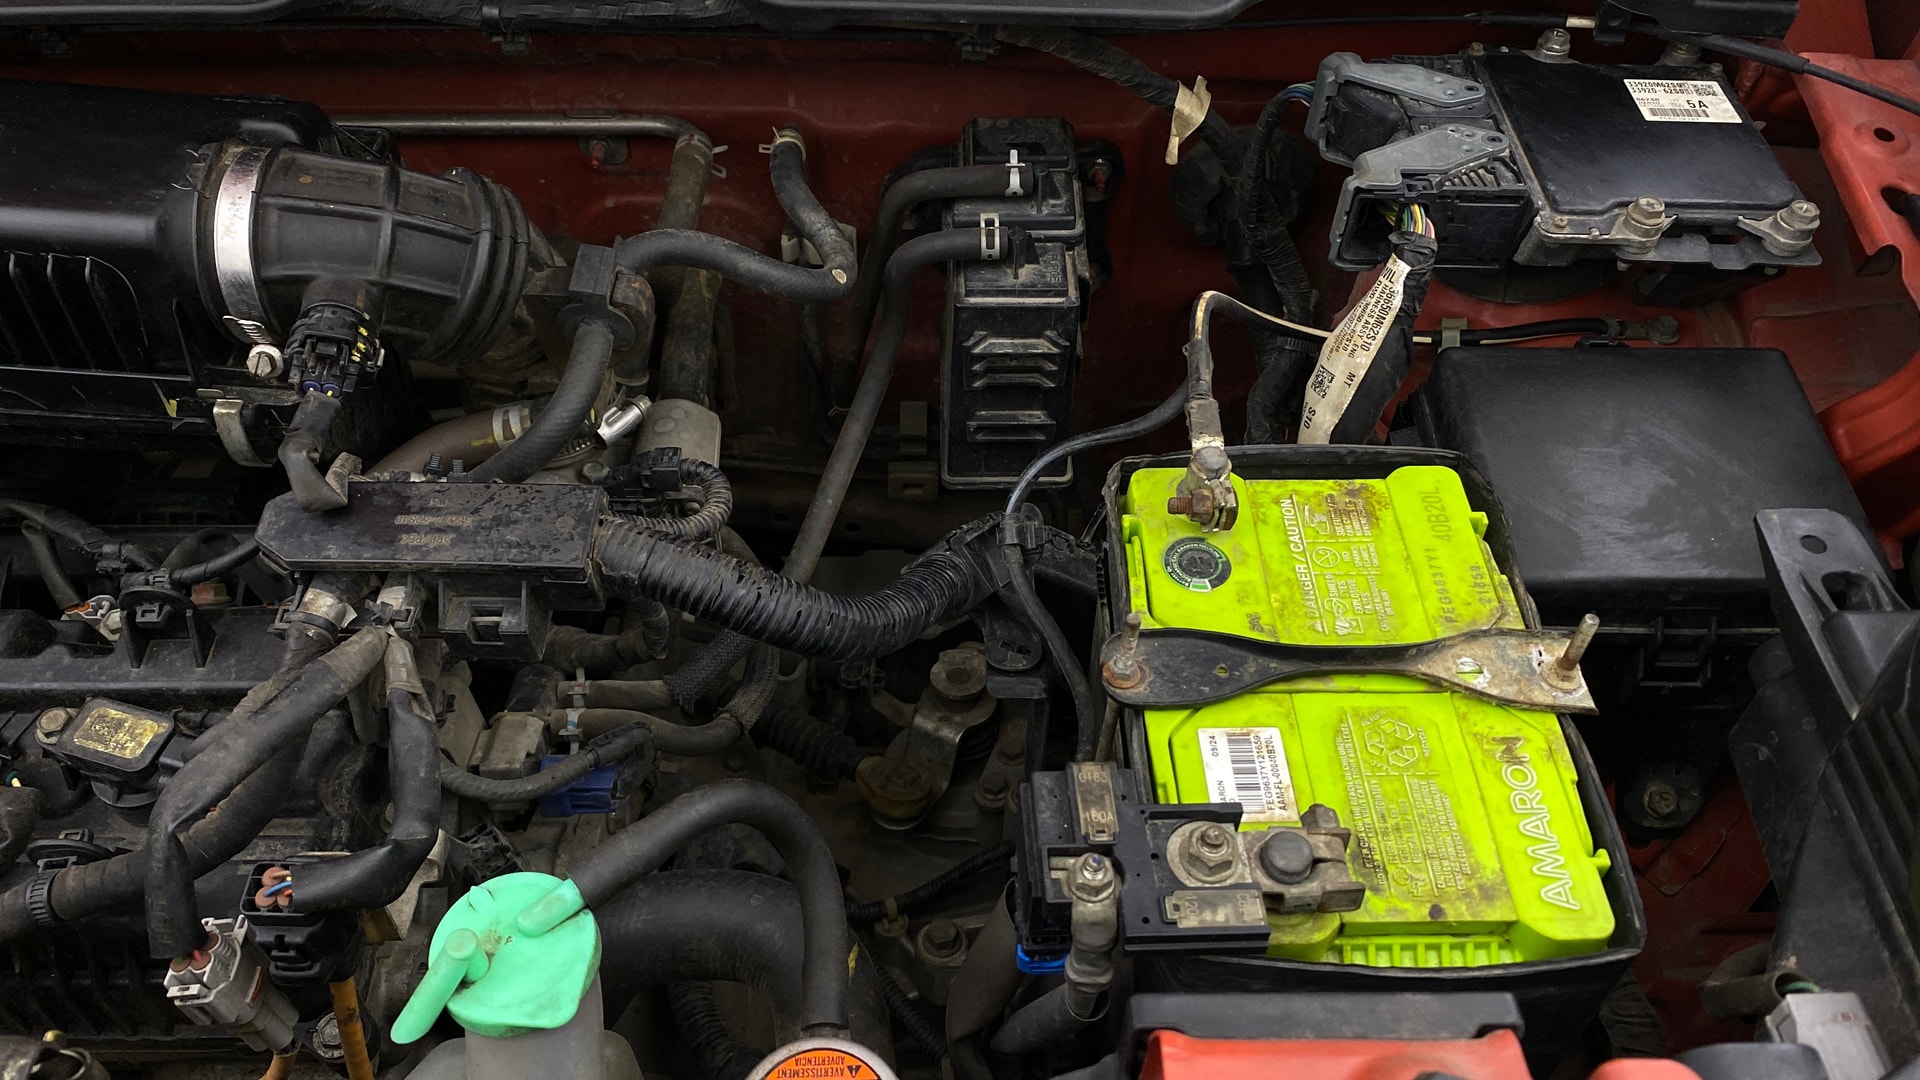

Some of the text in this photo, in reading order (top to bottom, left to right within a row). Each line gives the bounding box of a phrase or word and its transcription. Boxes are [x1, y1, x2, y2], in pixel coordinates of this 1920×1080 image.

[1360, 286, 1399, 352] 36650M62S10
[1368, 284, 1389, 319] HARNESS
[1358, 320, 1371, 340] ASSY
[1344, 372, 1356, 388] MT
[1304, 406, 1316, 429] S10
[1279, 497, 1303, 551] CAUTION
[1209, 736, 1227, 804] ARON 09/24
[1252, 735, 1275, 811] FEG9637Y121659
[1491, 736, 1580, 910] AMARON
[777, 1066, 844, 1078] AVERTISSEMENT
[794, 1056, 845, 1066] ADVERTENCIA
